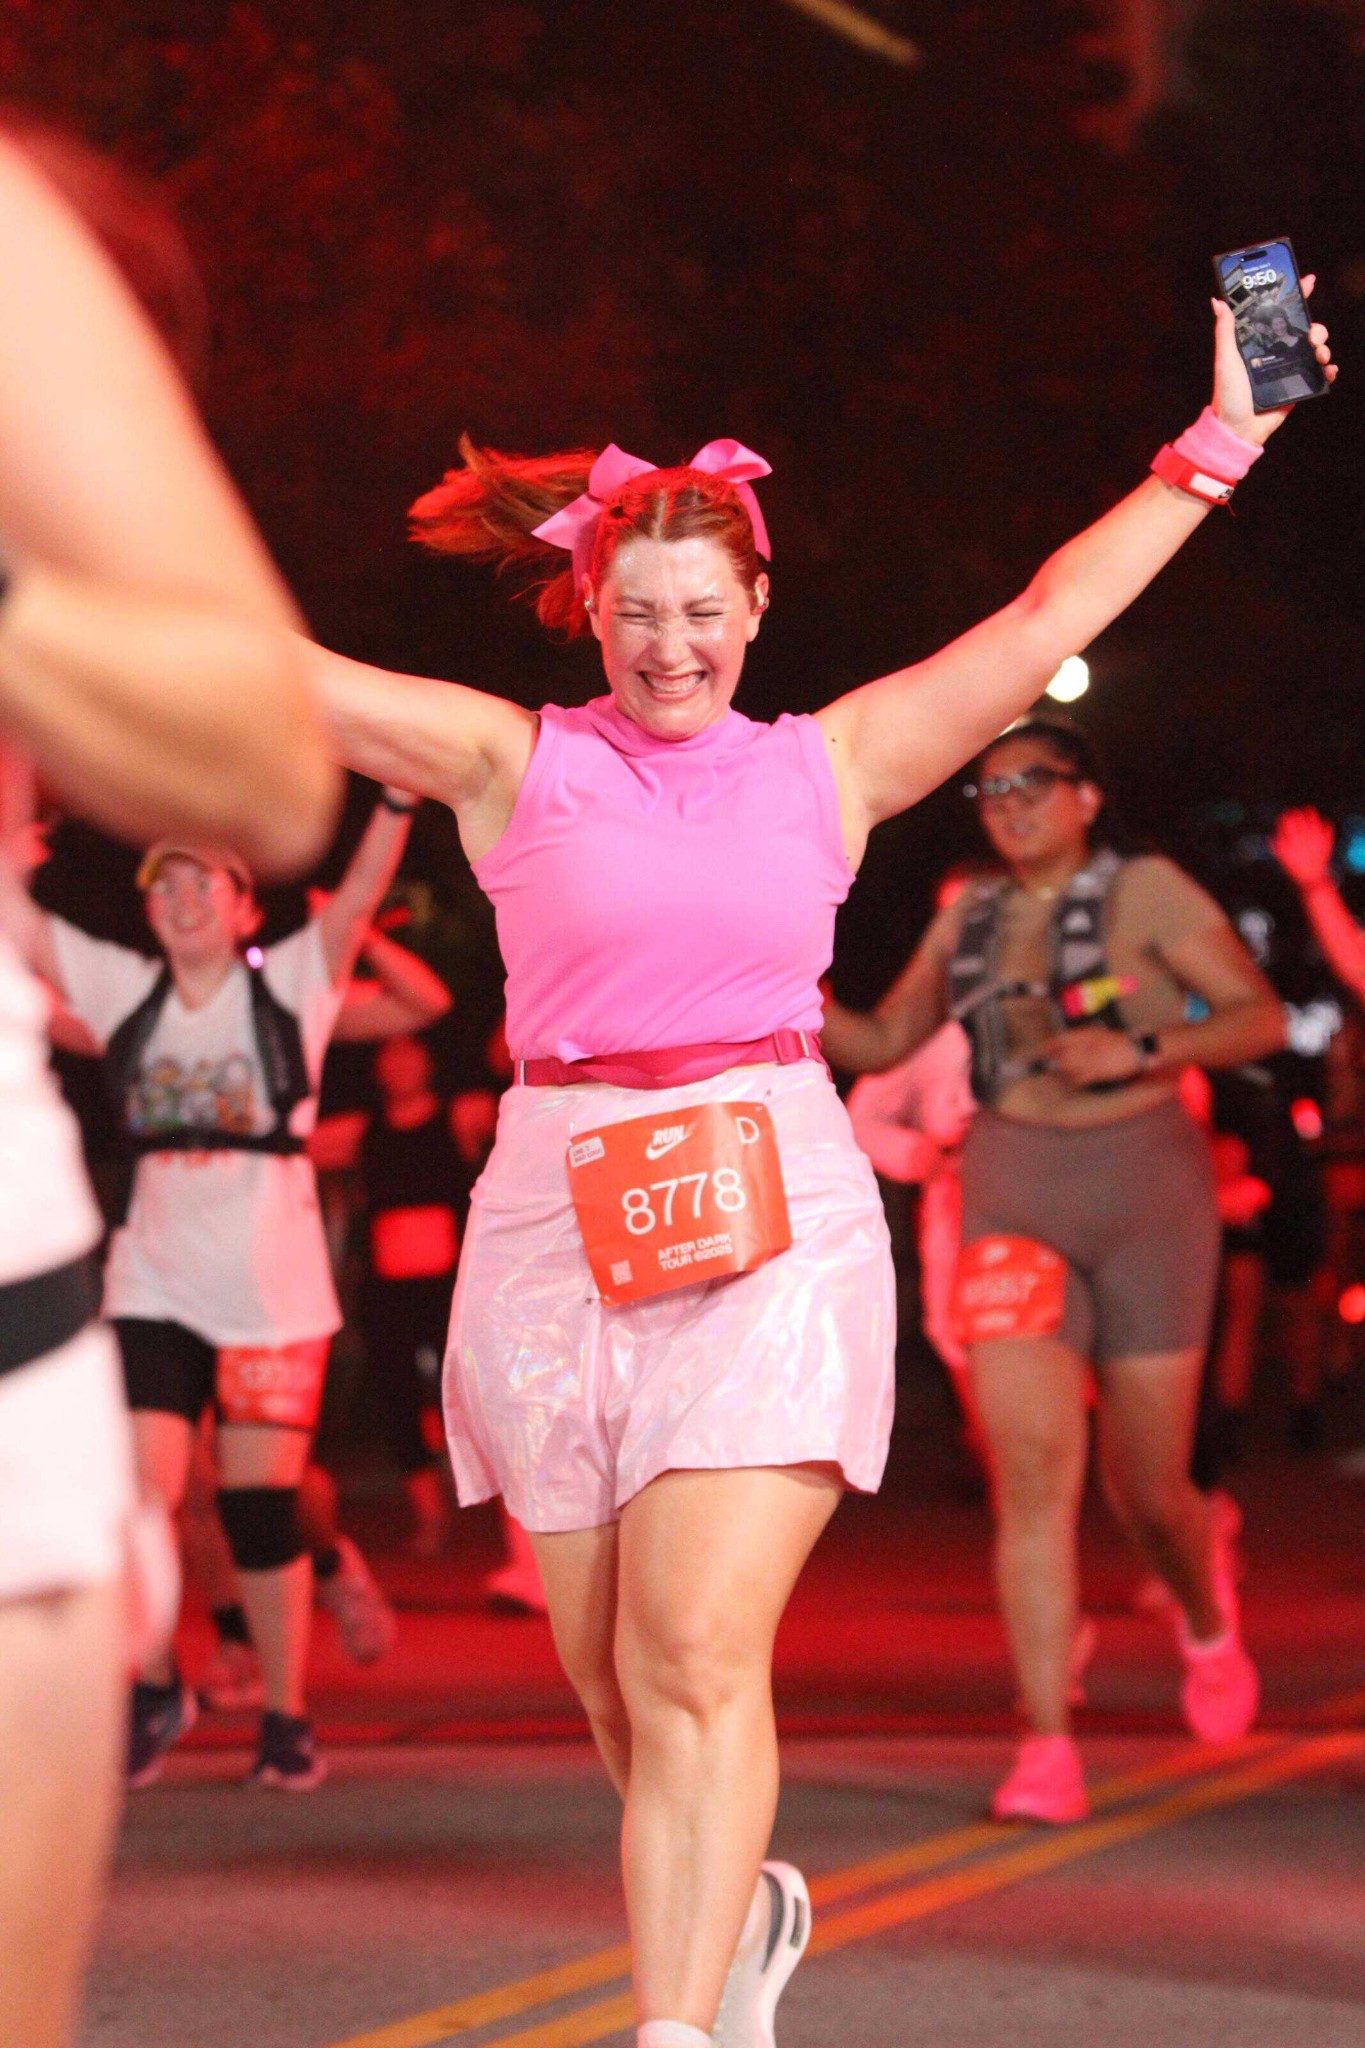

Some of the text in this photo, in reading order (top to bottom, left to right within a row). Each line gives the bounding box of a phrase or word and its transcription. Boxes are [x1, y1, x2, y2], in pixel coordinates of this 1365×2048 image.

[1243, 269, 1277, 290] 9:50
[652, 1124, 686, 1147] RUN
[735, 1116, 760, 1144] D
[621, 1167, 747, 1236] 8778
[658, 1233, 733, 1262] AFTER DARK
[659, 1253, 694, 1272] TOUR
